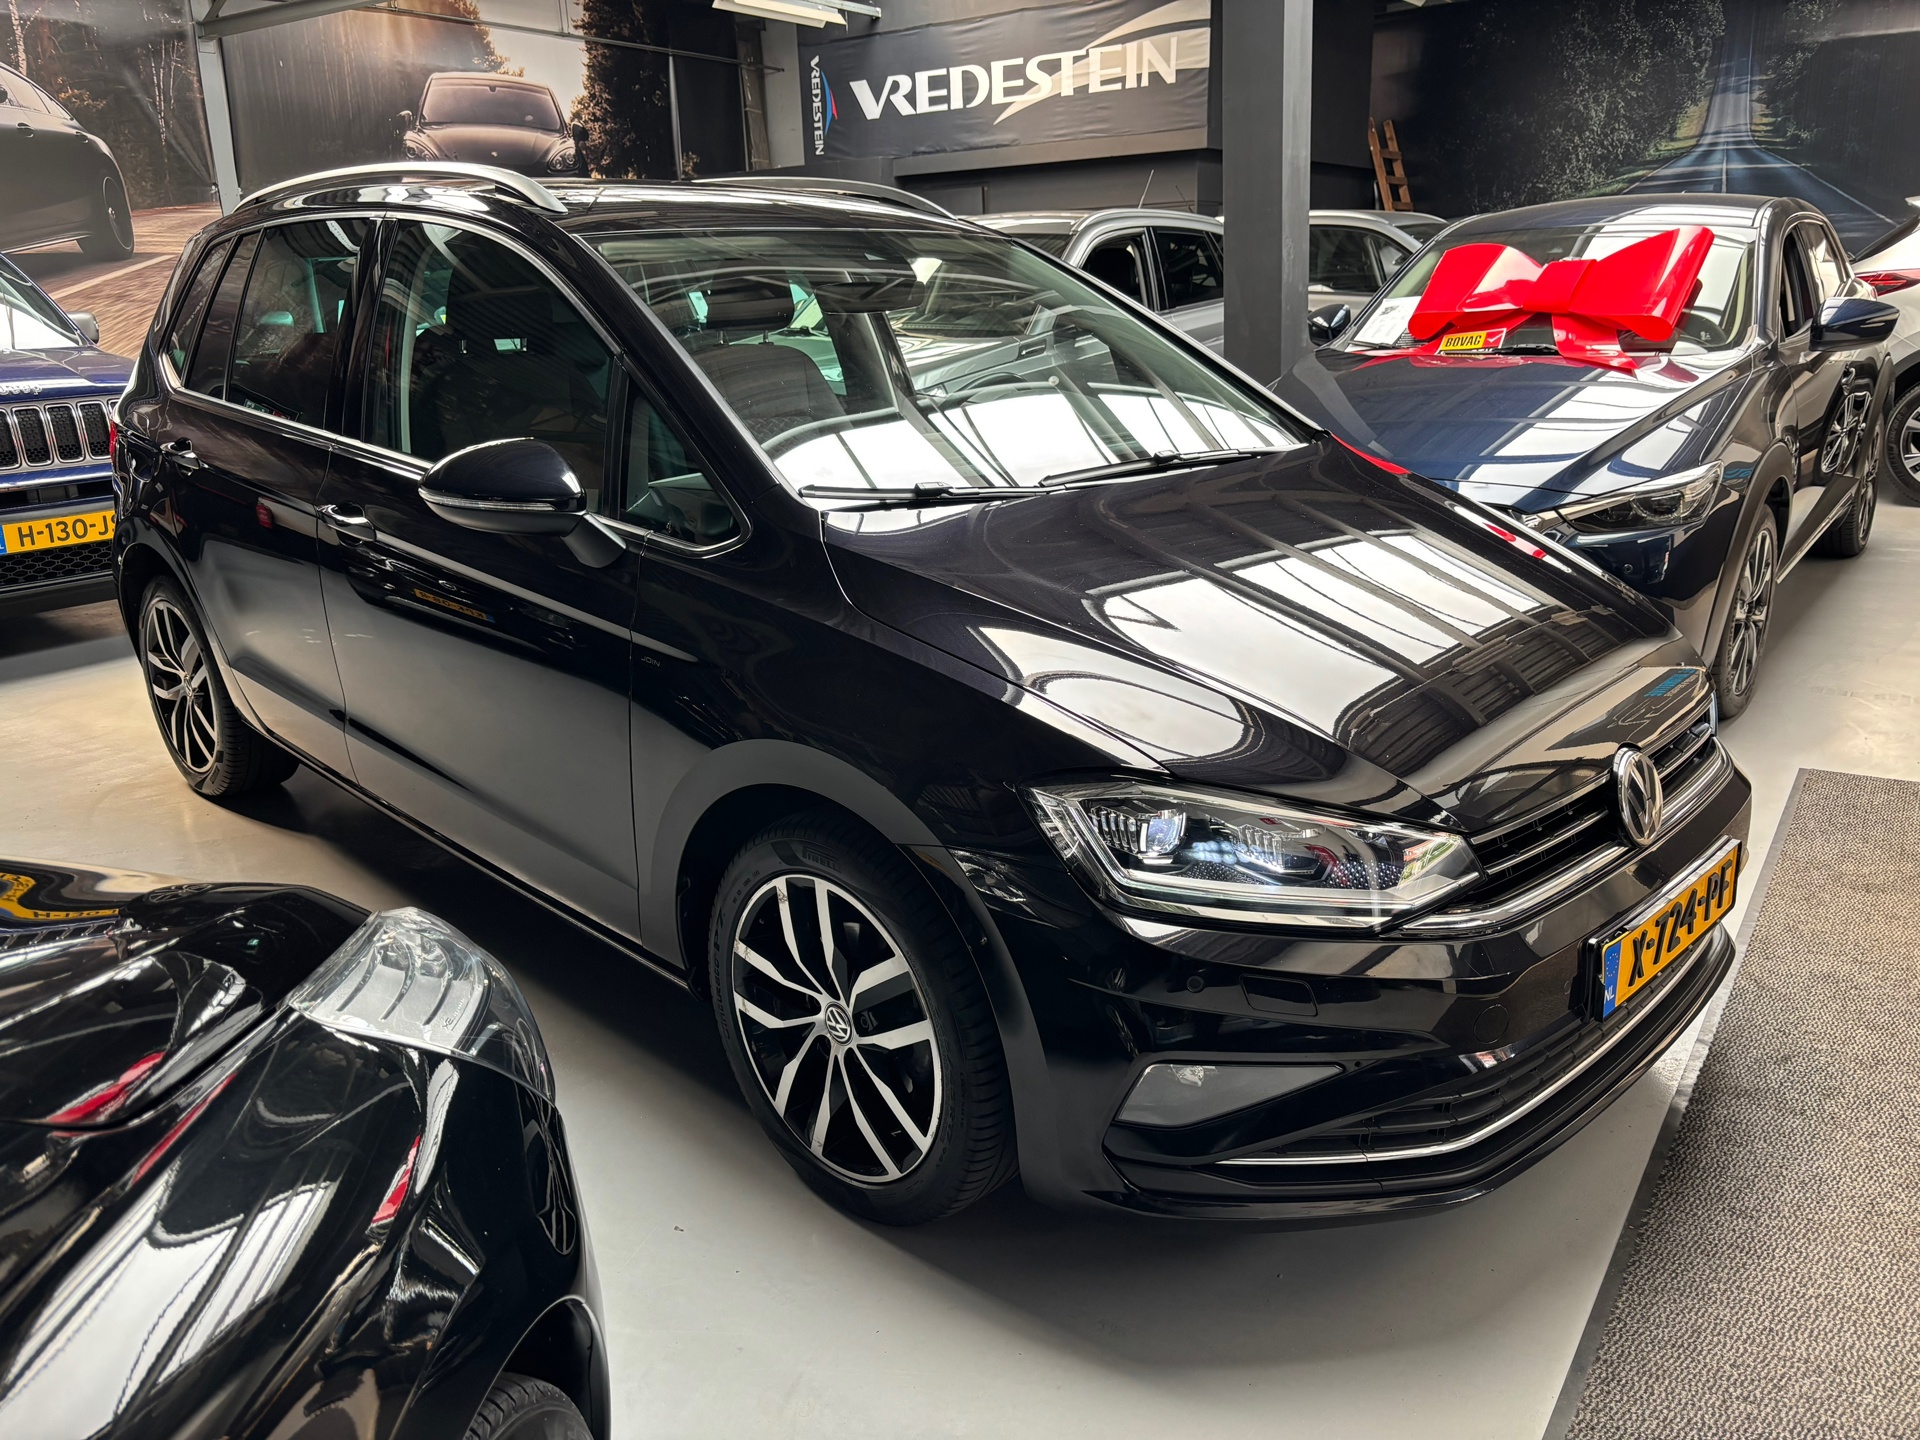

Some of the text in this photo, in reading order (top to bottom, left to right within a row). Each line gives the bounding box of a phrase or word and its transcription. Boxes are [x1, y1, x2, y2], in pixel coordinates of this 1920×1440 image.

[849, 36, 1177, 121] VREDESTEIN
[810, 55, 824, 156] VREDESTEIN
[1445, 335, 1482, 347] BOVAG
[641, 656, 660, 667] JOIN
[1627, 858, 1733, 988] X-724-PF
[1604, 984, 1615, 1005] NL
